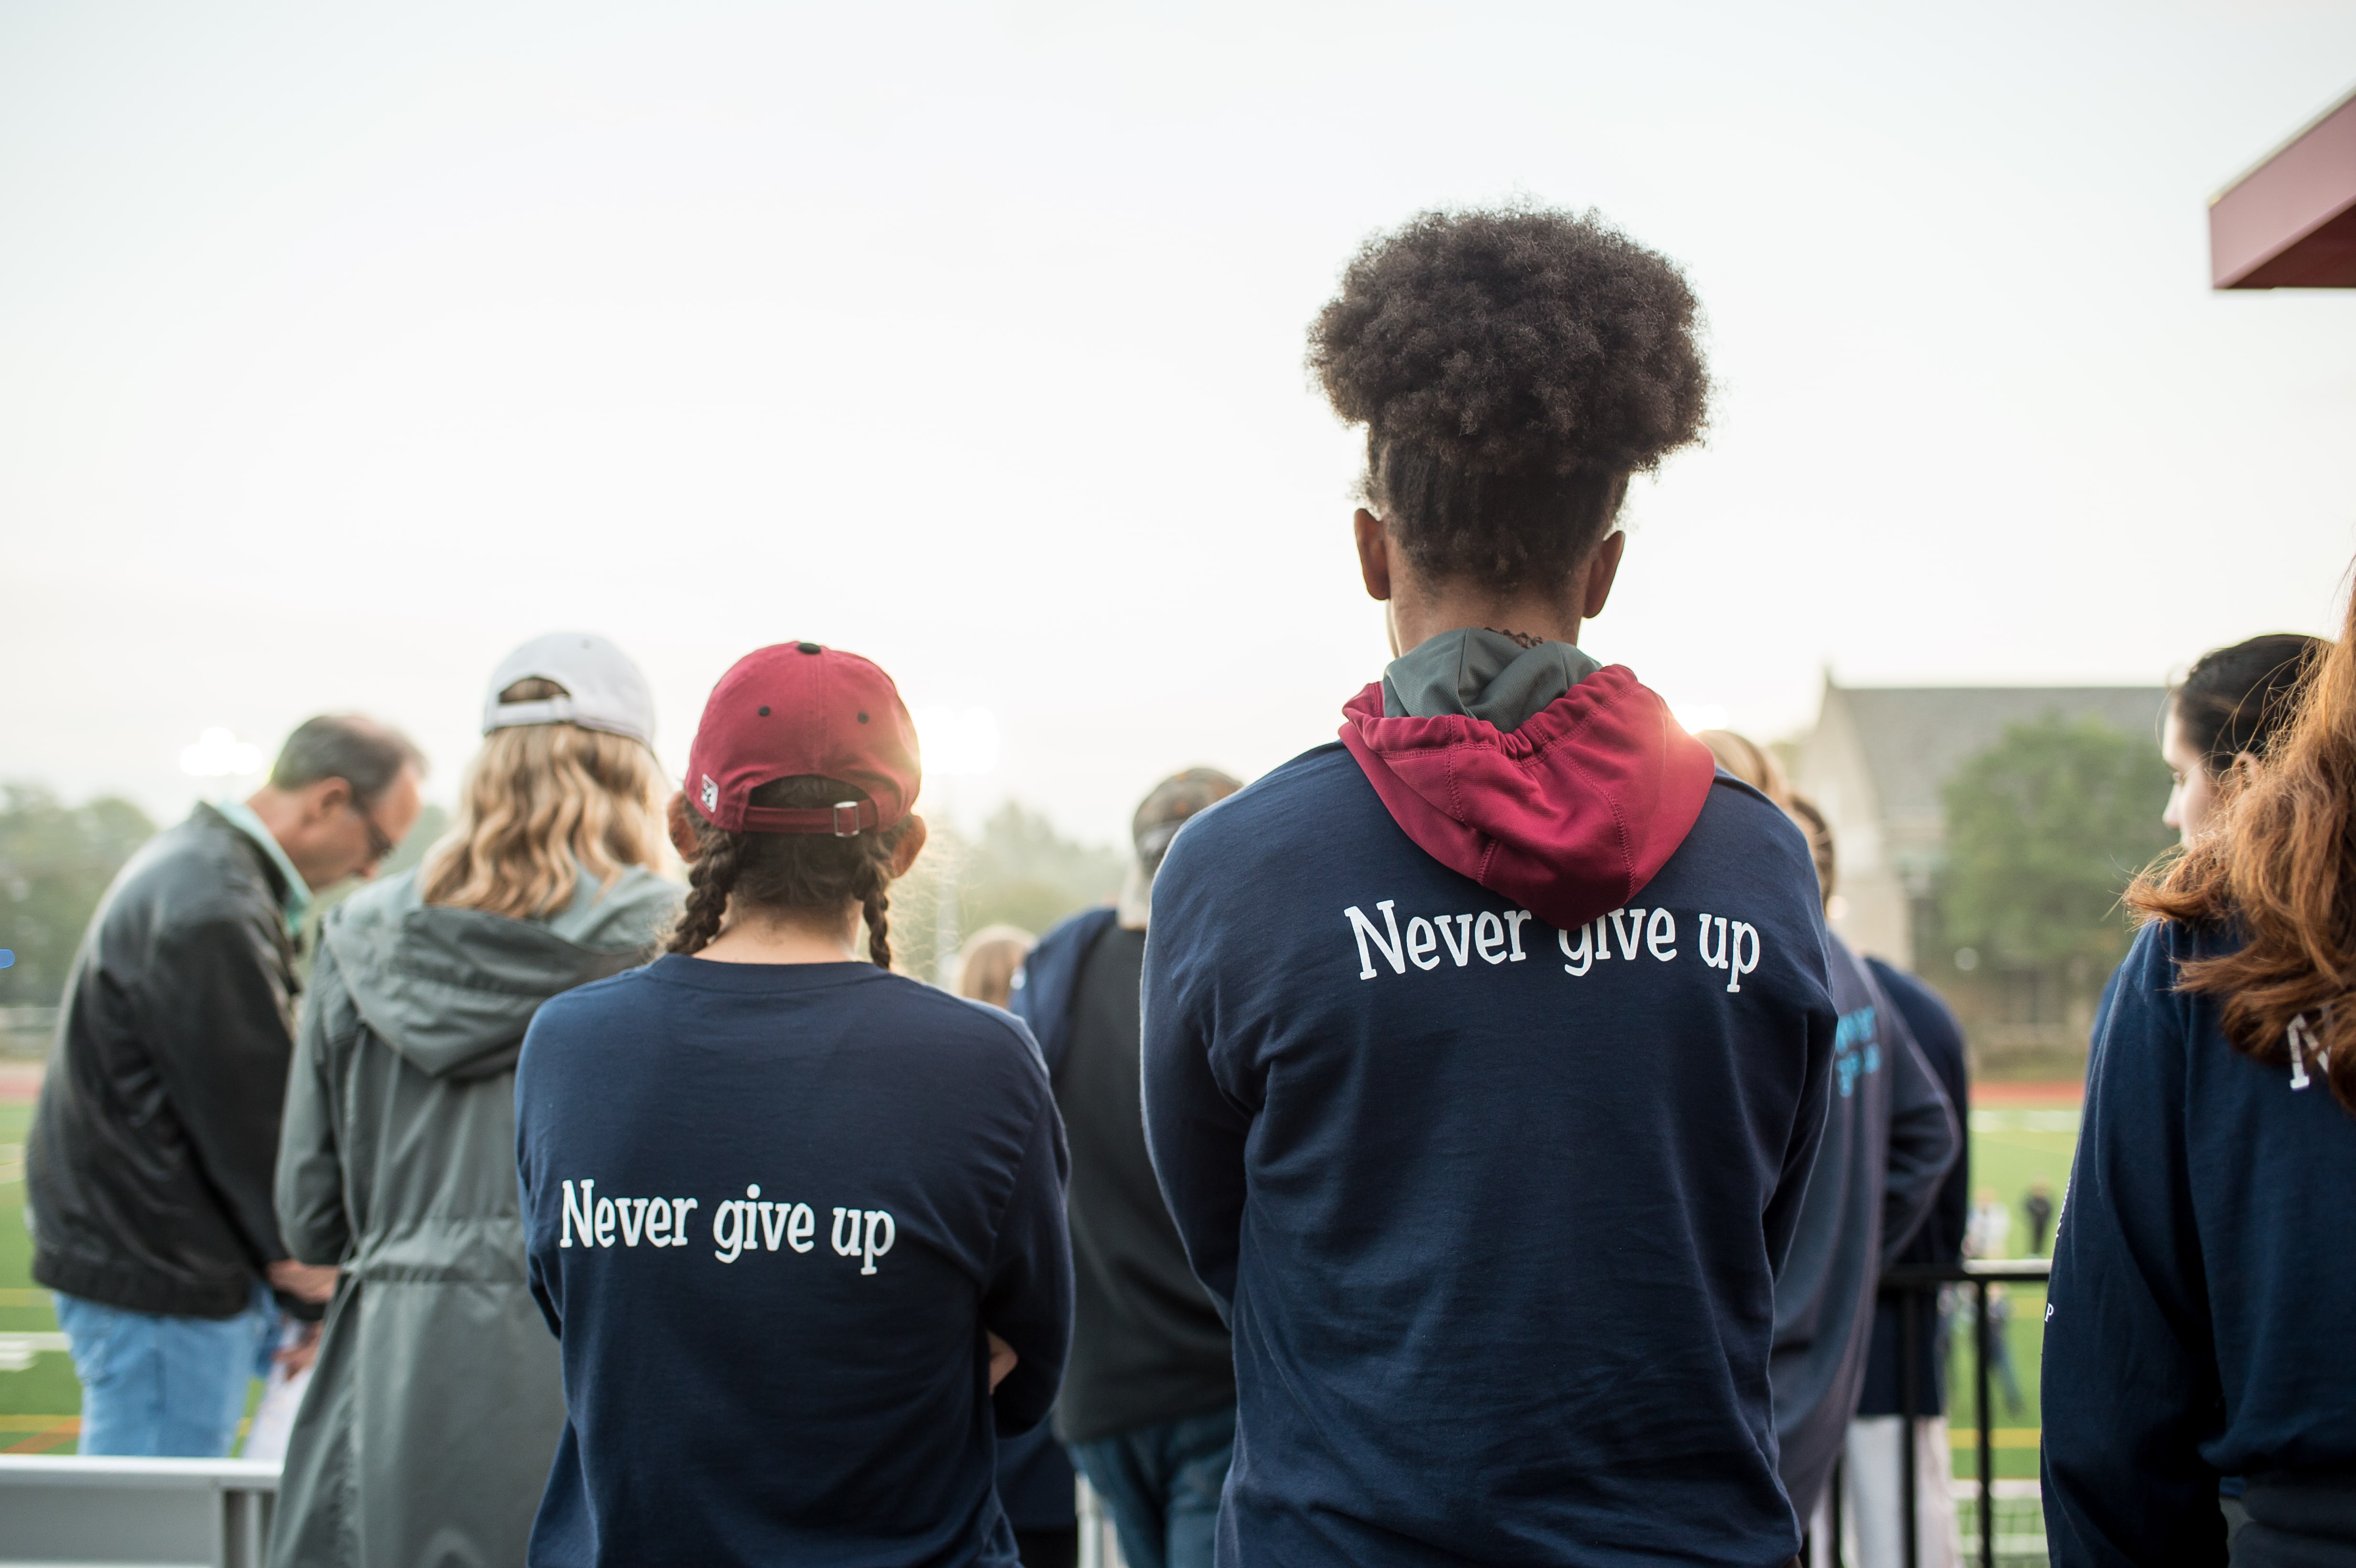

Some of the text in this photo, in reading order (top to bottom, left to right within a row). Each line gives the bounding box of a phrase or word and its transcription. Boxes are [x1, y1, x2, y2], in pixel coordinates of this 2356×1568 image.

[1343, 899, 1760, 993] Never give up
[560, 1179, 895, 1275] Never give up
